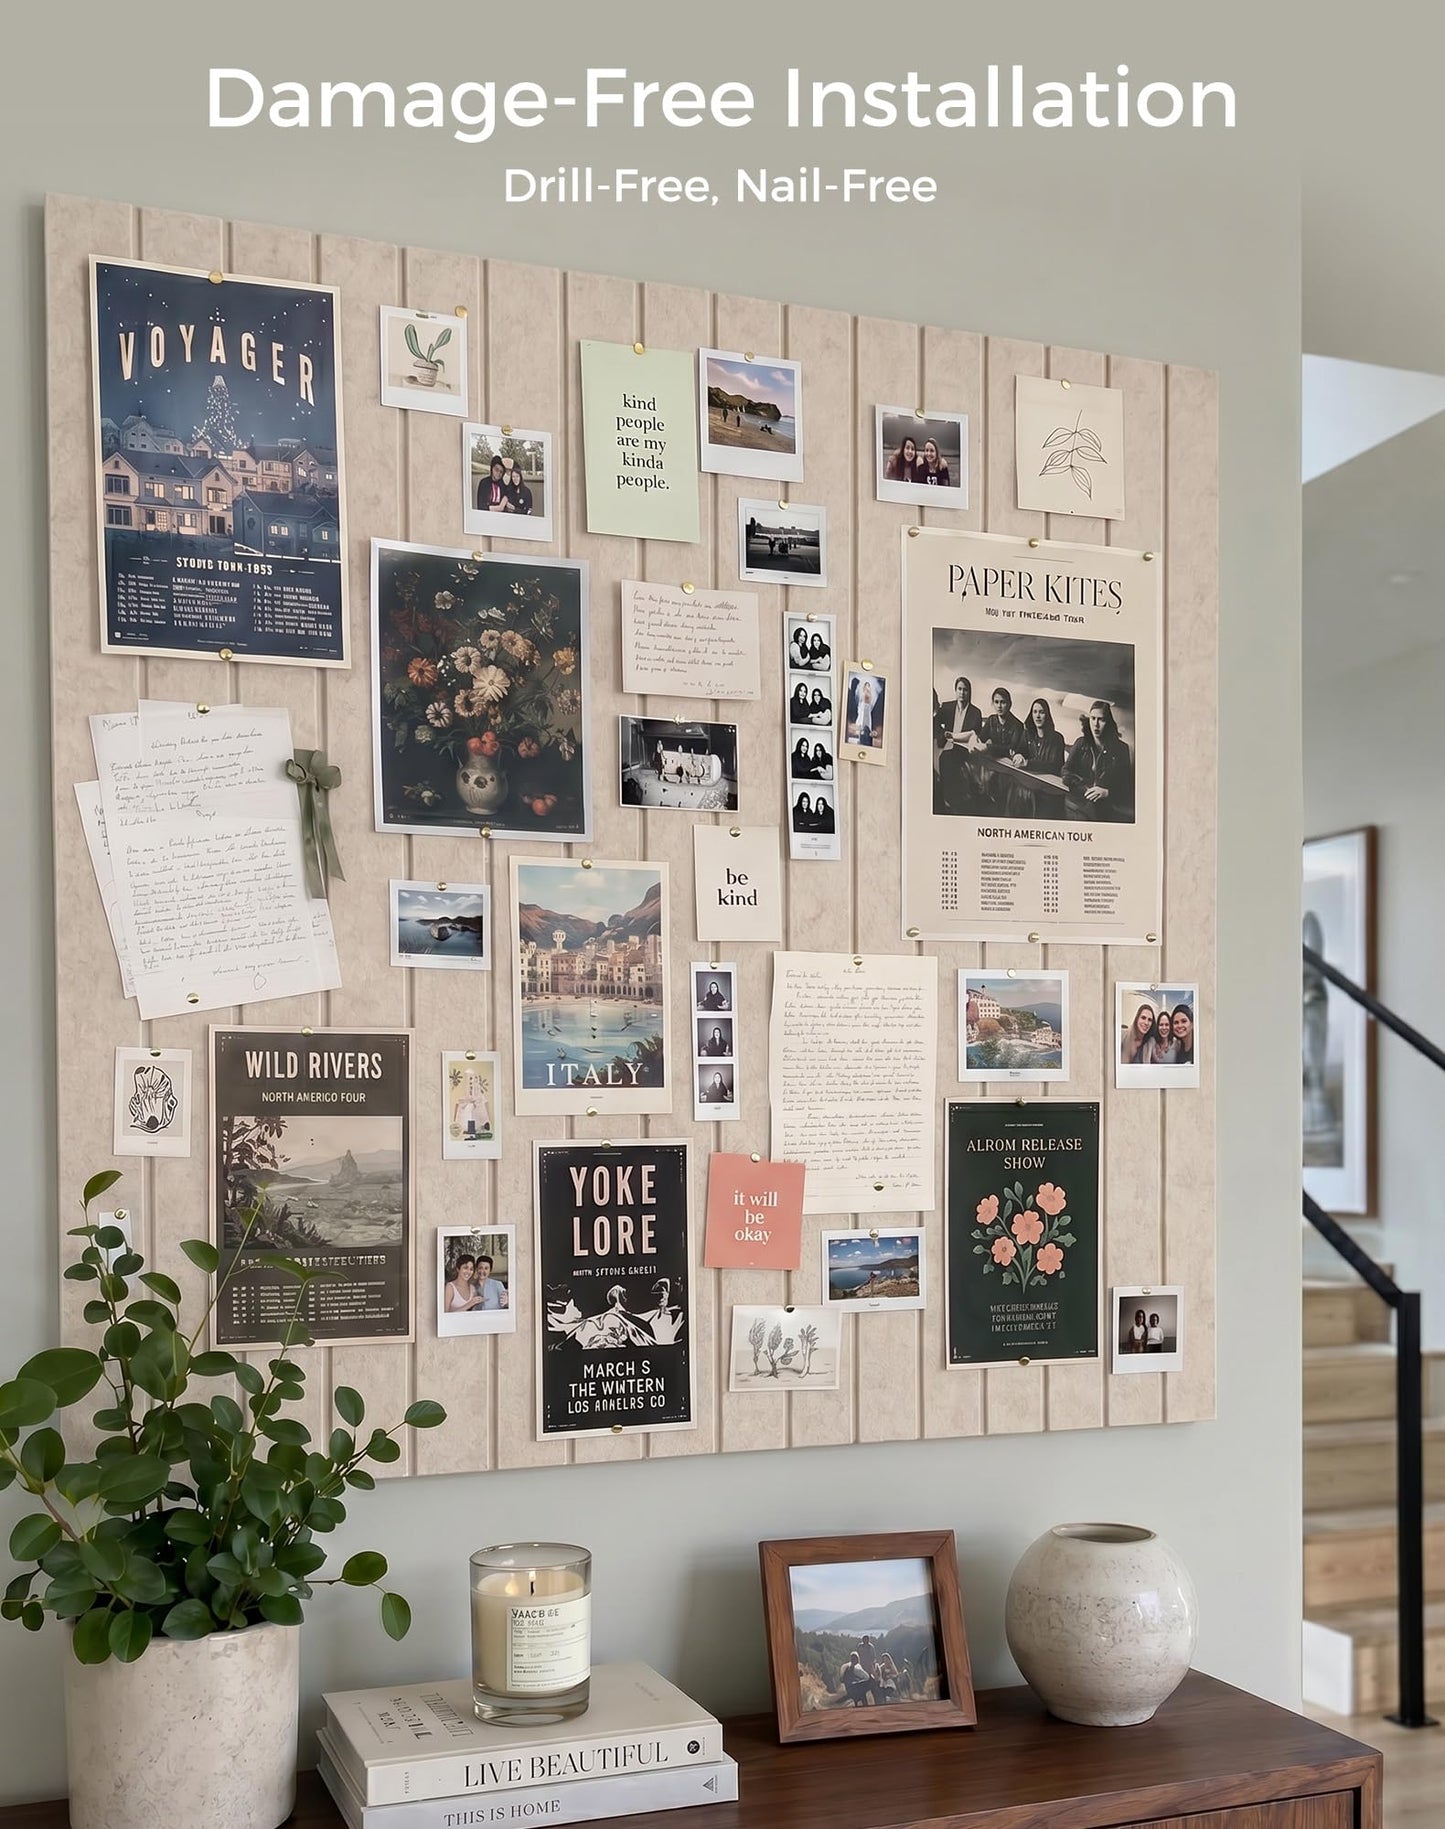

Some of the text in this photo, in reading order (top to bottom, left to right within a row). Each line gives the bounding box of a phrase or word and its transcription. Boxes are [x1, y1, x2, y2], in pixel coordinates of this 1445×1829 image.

[118, 324, 315, 407] VOYAGER
[622, 393, 656, 412] kind
[616, 416, 665, 434] people
[617, 436, 667, 456] are my
[622, 452, 664, 470] kinda
[616, 474, 670, 492] people.
[948, 564, 1122, 612] PAPER KITES
[977, 828, 1012, 838] NORTH
[1014, 829, 1064, 841] AMERICAN
[726, 867, 749, 886] be
[718, 888, 758, 906] kind
[245, 1051, 383, 1080] WILD RIVERS
[546, 1062, 644, 1086] ITALY
[262, 1092, 294, 1102] NORTH
[341, 1092, 366, 1103] FOUR
[966, 1138, 1083, 1152] ALROM RELEASE
[1004, 1156, 1046, 1170] SHOW
[569, 1165, 657, 1207] YOKE
[734, 1190, 778, 1207] it will
[745, 1209, 765, 1225] be
[572, 1214, 657, 1257] LORE
[734, 1226, 772, 1246] okay
[583, 1360, 635, 1379] MARCH
[569, 1382, 597, 1398] THE
[568, 1400, 590, 1414] LOS
[650, 1394, 666, 1408] CO
[464, 1759, 522, 1788] LIVE
[530, 1742, 669, 1779] BEAUTIFUL
[444, 1800, 561, 1827] THIS IS HOME
